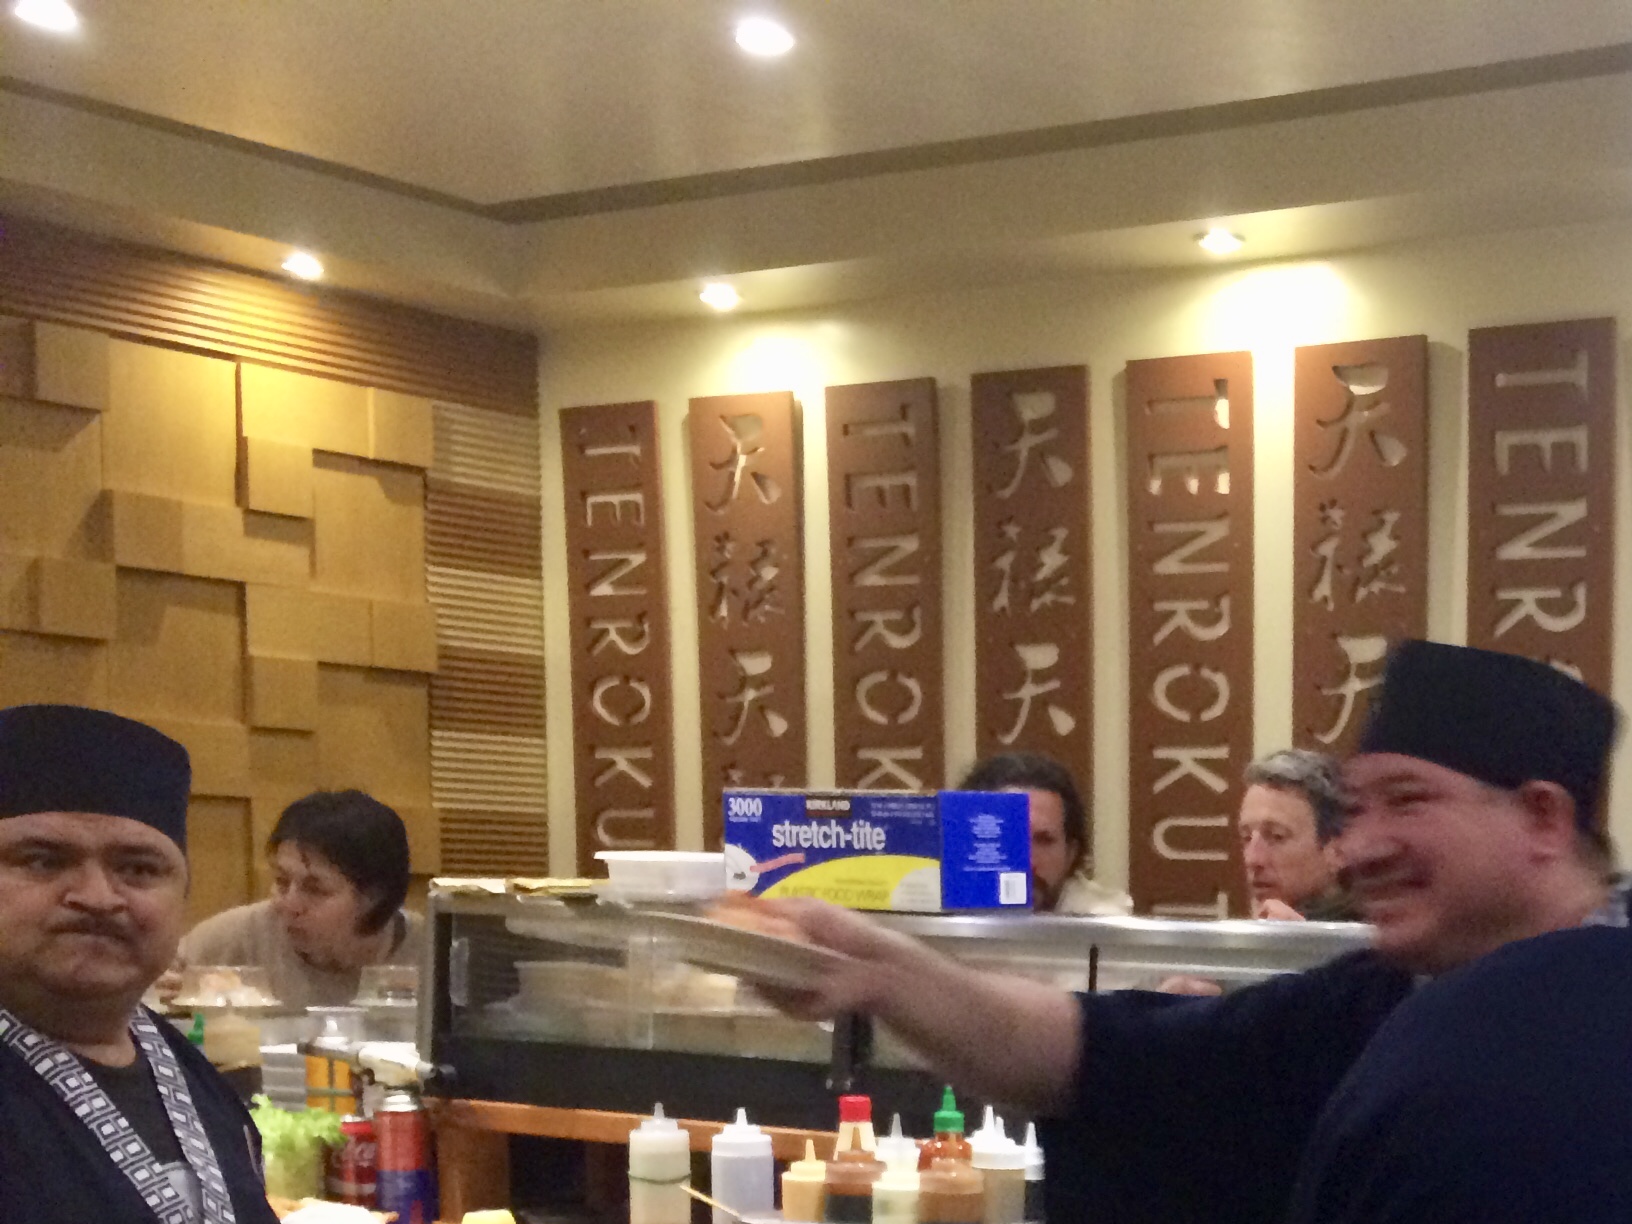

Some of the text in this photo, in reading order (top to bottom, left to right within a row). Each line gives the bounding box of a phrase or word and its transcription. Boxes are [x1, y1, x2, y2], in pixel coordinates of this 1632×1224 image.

[1493, 350, 1590, 682] TENR
[576, 422, 655, 849] TENROKU
[728, 797, 763, 816] 3000
[772, 819, 886, 850] stretch-tite
